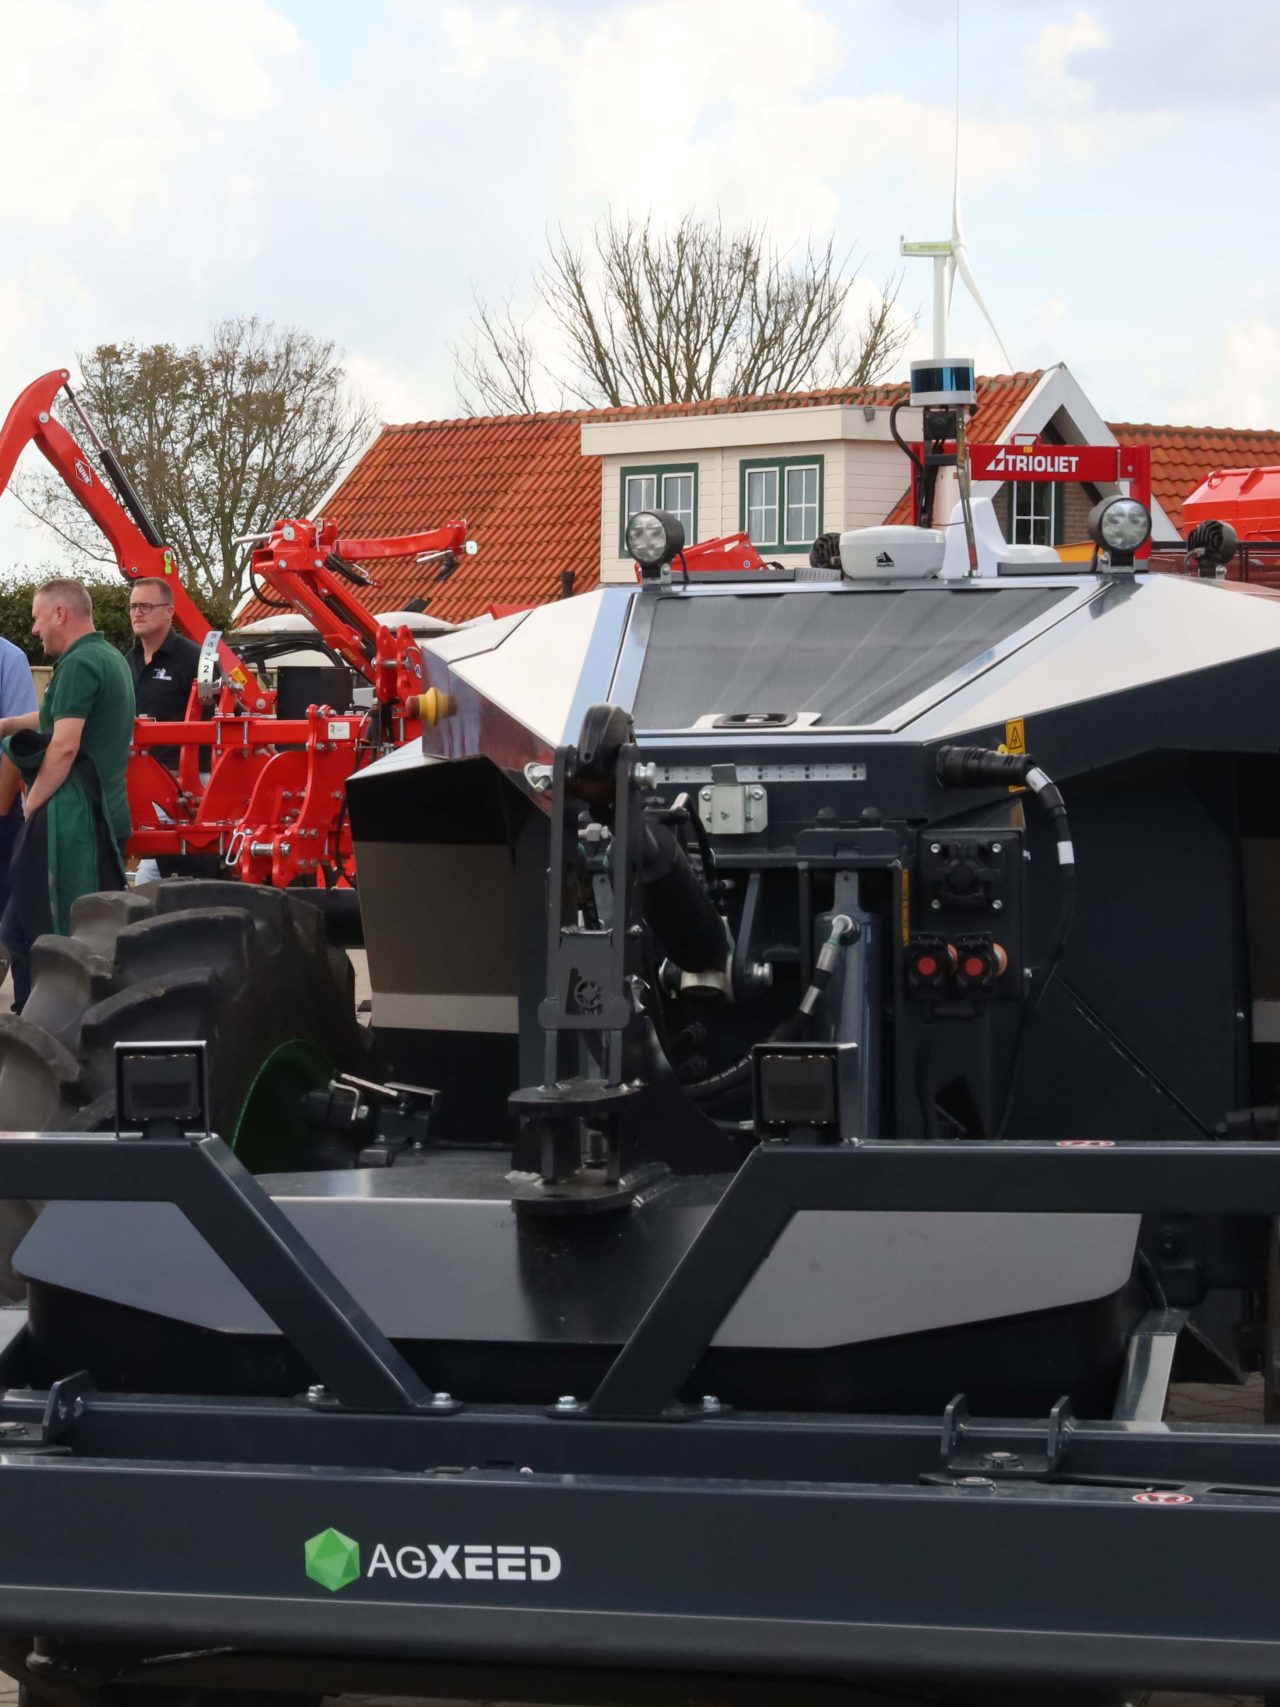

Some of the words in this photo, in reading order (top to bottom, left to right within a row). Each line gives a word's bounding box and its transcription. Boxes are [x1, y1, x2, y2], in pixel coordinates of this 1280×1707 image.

[1005, 454, 1080, 473] TRIOLIET
[202, 664, 210, 674] 2
[366, 1543, 562, 1582] AGXEED
